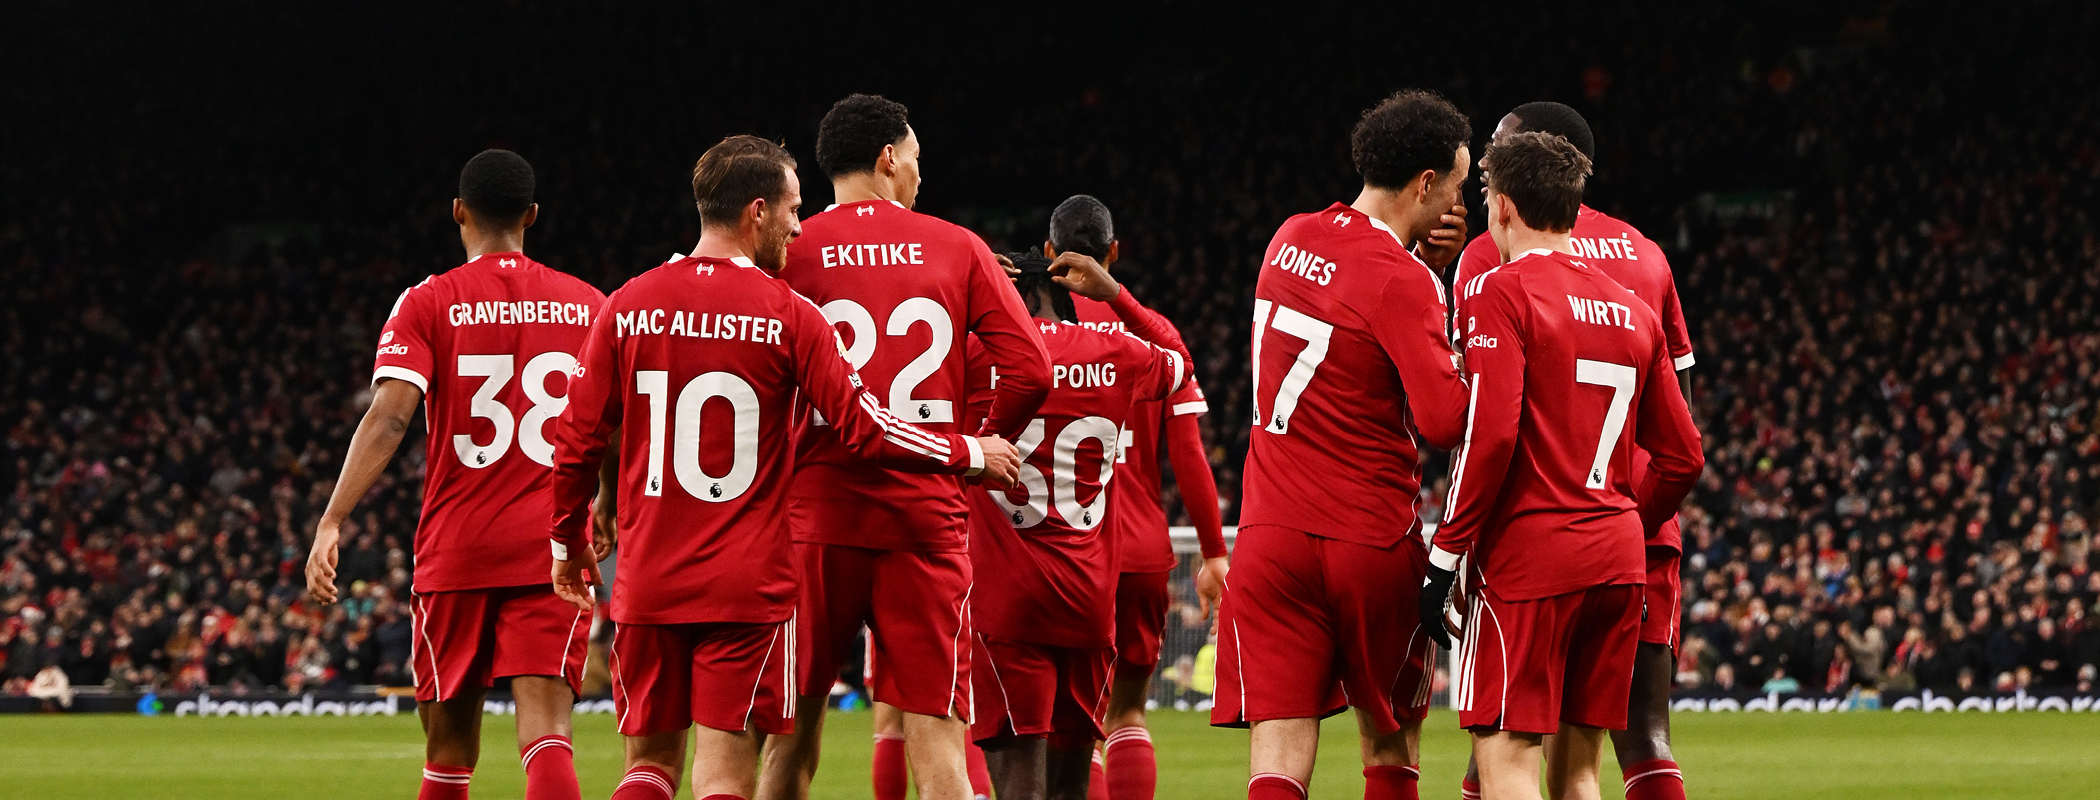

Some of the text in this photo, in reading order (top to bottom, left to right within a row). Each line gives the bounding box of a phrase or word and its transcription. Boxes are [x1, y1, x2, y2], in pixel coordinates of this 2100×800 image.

[821, 243, 923, 268] EKITIKE
[1271, 243, 1336, 286] JONES
[1569, 232, 1638, 261] ONATÉ
[448, 301, 590, 326] GRAVENBERCH
[616, 309, 783, 345] MAC ALLISTER
[1567, 295, 1636, 331] WIRTZ
[376, 343, 408, 359] edia
[1467, 334, 1497, 349] edia
[1253, 298, 1334, 434] 17
[453, 352, 577, 469] 38
[1576, 359, 1637, 491] 7
[637, 370, 760, 502] 10
[982, 416, 1118, 531] 30
